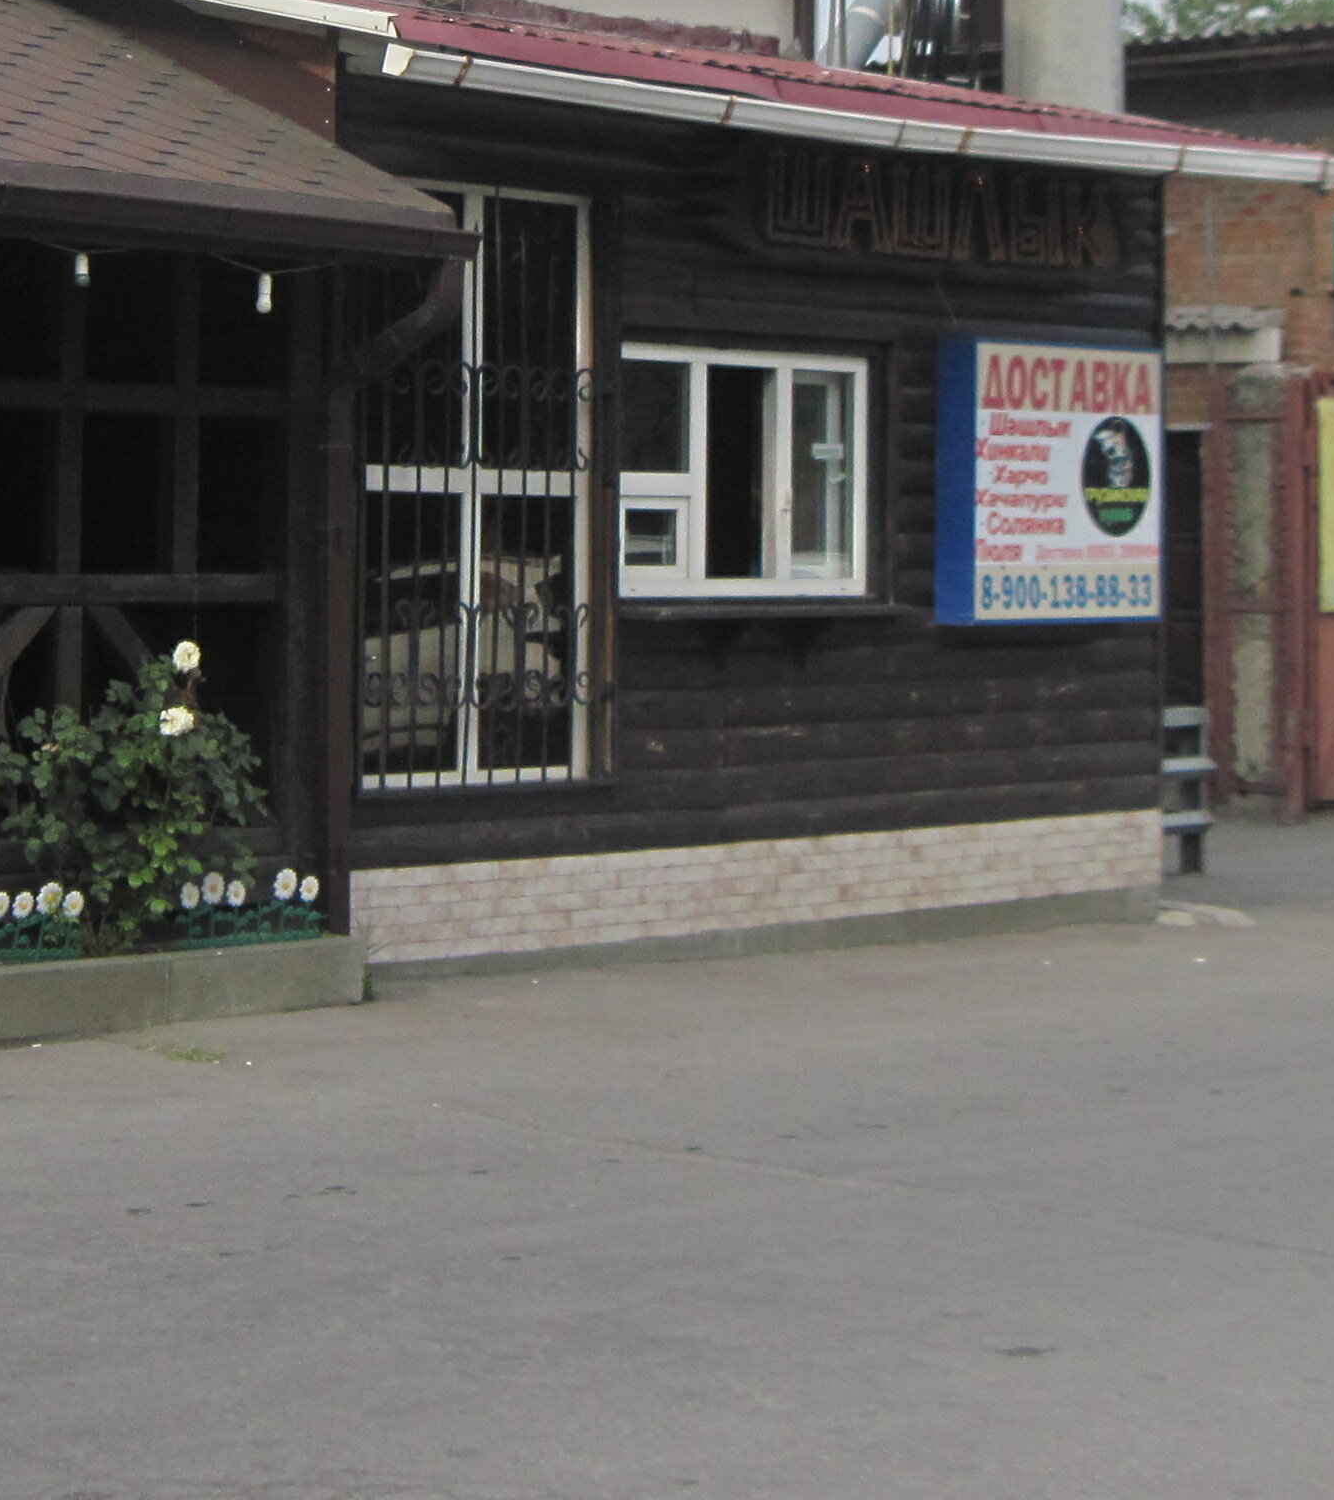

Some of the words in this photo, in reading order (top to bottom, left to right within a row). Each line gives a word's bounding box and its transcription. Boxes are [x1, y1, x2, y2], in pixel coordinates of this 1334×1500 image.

[766, 148, 1119, 267] ШАШЛЫК
[980, 355, 1153, 414] ДОСТАВКА
[989, 413, 1071, 437] Шашлык
[987, 512, 1067, 535] Солянка
[981, 574, 1153, 611] 8-900-138-88-33
